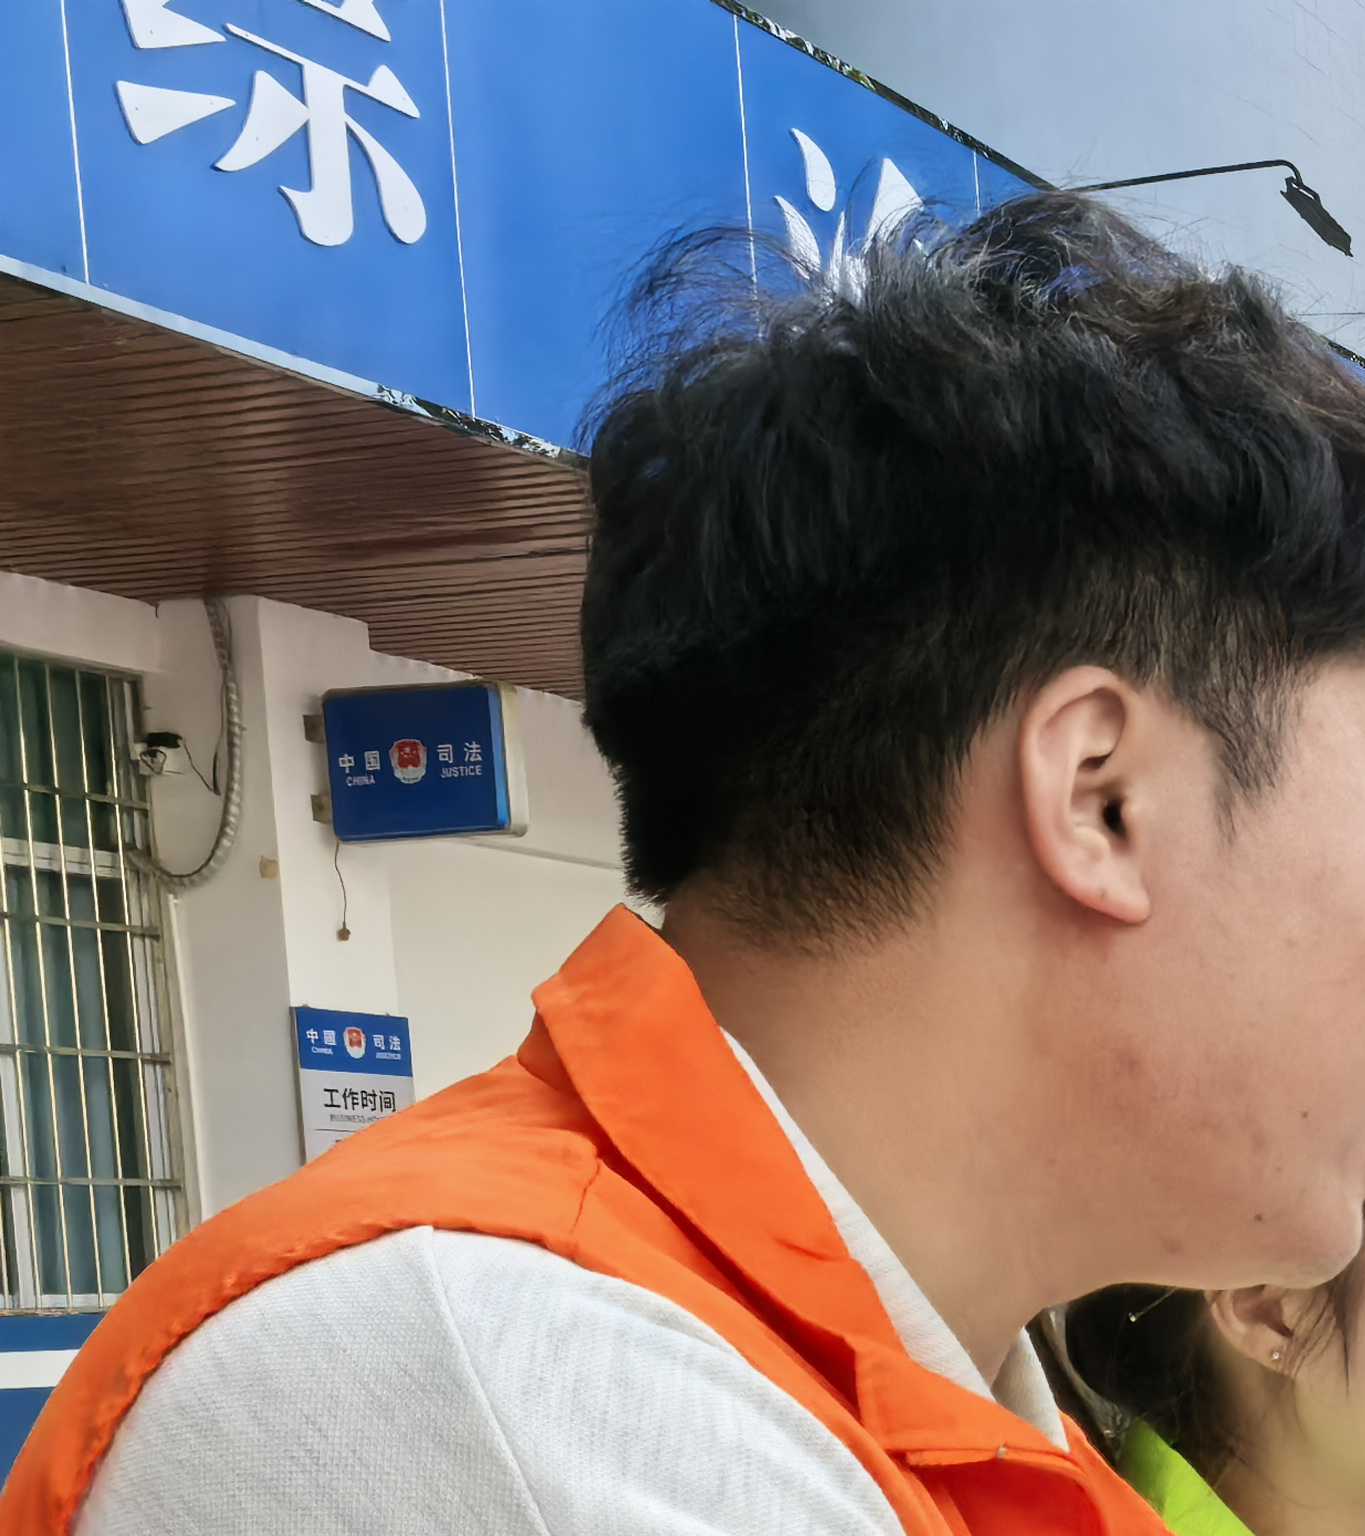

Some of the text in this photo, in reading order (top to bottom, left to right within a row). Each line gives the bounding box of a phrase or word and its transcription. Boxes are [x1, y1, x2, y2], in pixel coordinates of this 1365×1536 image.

[339, 741, 483, 774] 中国 司法
[346, 765, 482, 787] CHINA JUSTICE
[323, 1087, 397, 1113] 工作时间
